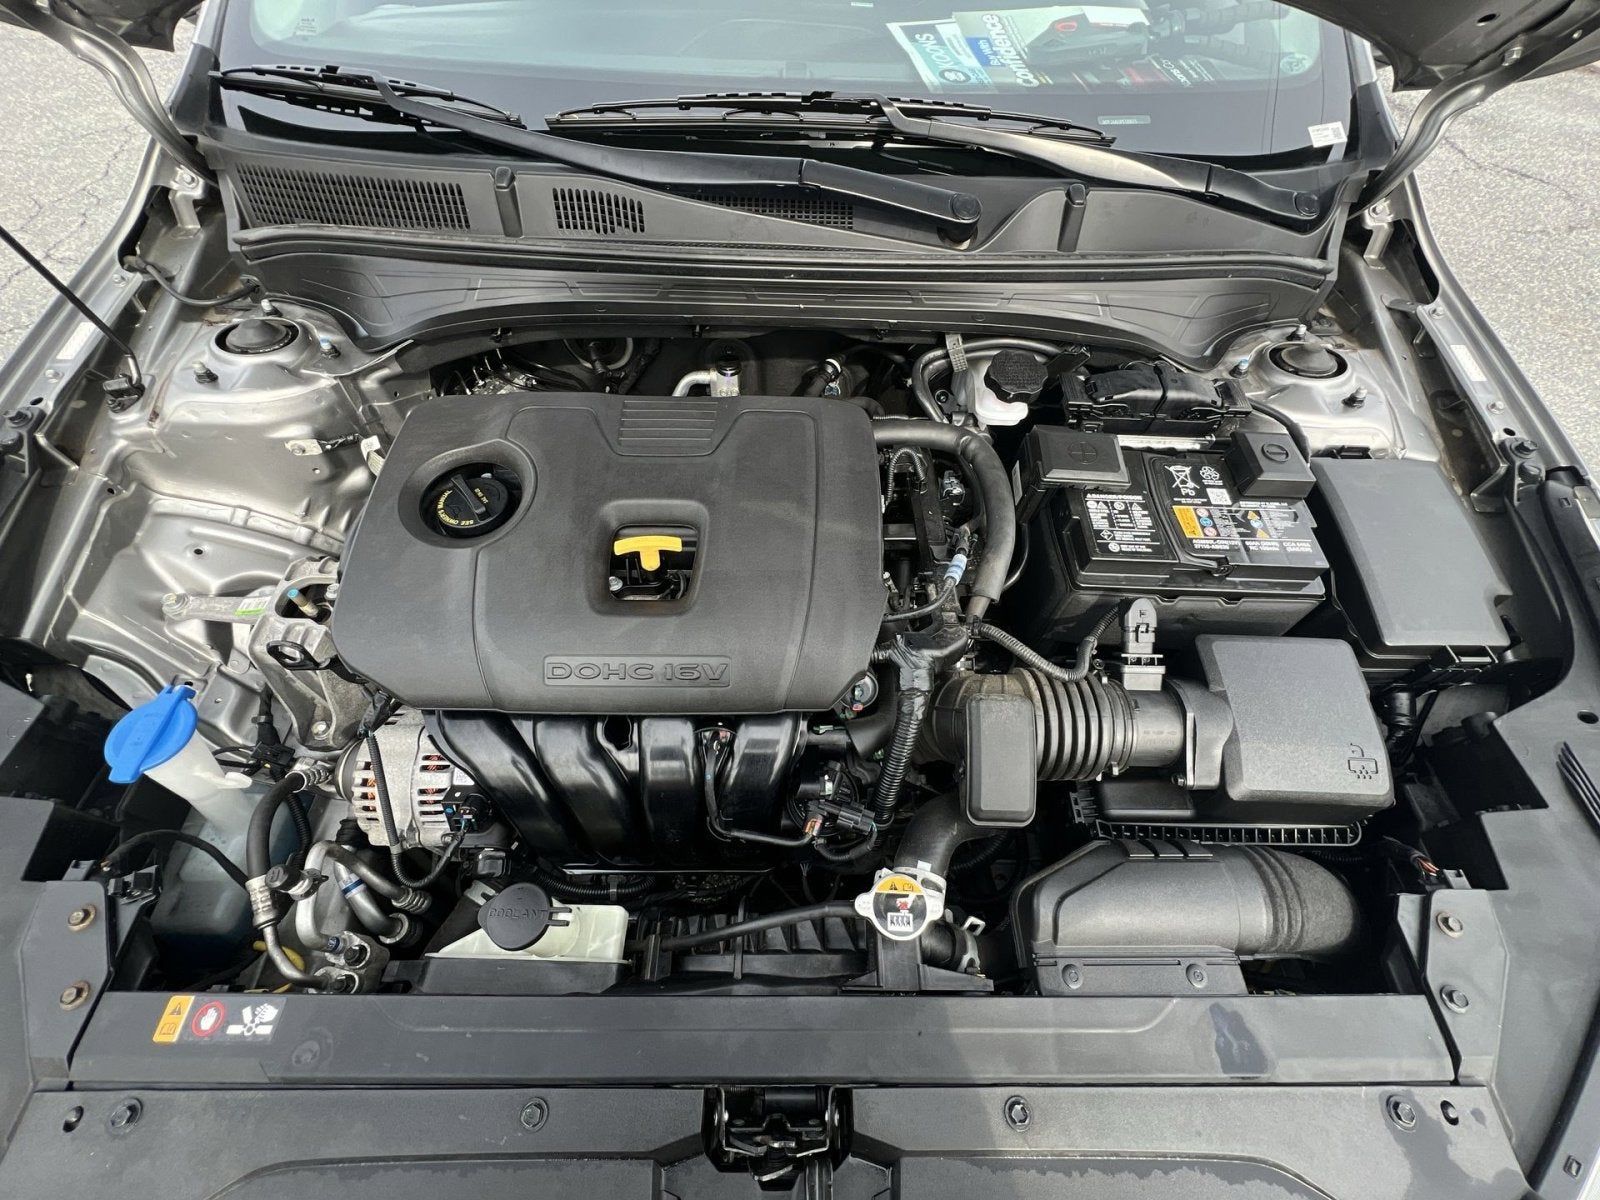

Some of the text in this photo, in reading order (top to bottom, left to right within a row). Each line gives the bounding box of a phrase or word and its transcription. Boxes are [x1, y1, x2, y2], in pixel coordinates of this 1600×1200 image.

[915, 33, 954, 69] KOONS
[982, 14, 1040, 88] Confidence
[1181, 488, 1196, 496] Pb
[547, 662, 728, 681] DOHC 16V
[489, 907, 549, 919] COOLANT
